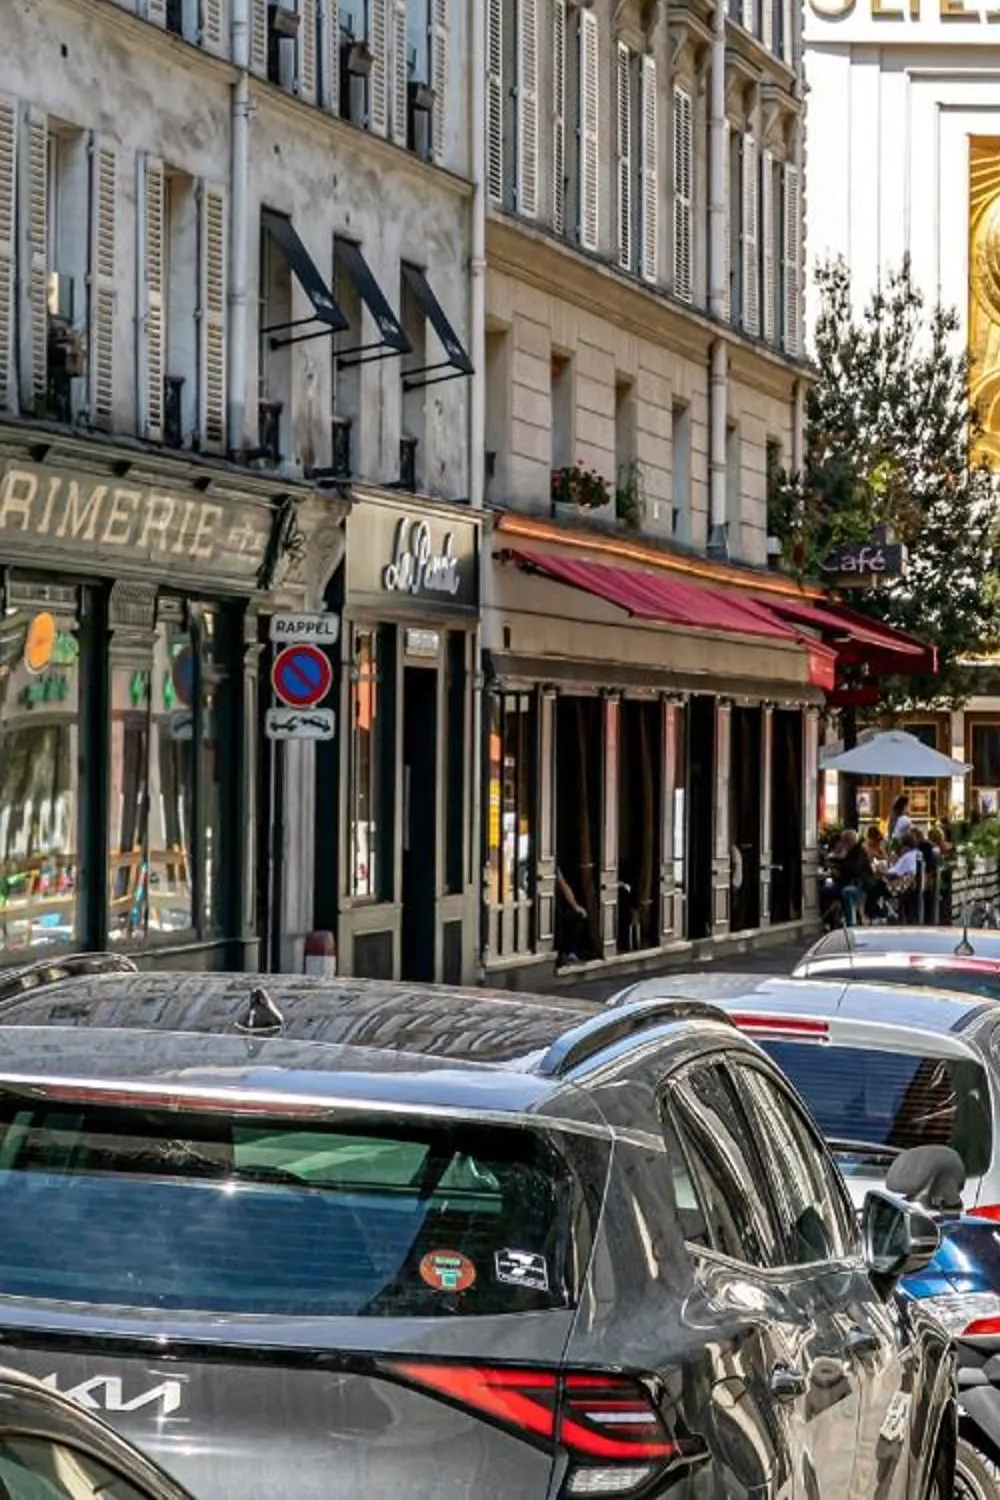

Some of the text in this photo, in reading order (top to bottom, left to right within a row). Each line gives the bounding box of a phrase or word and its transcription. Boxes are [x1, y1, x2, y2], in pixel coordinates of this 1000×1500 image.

[0, 469, 224, 557] RIMERIE
[819, 547, 885, 573] Café
[275, 620, 335, 635] RAPPEL
